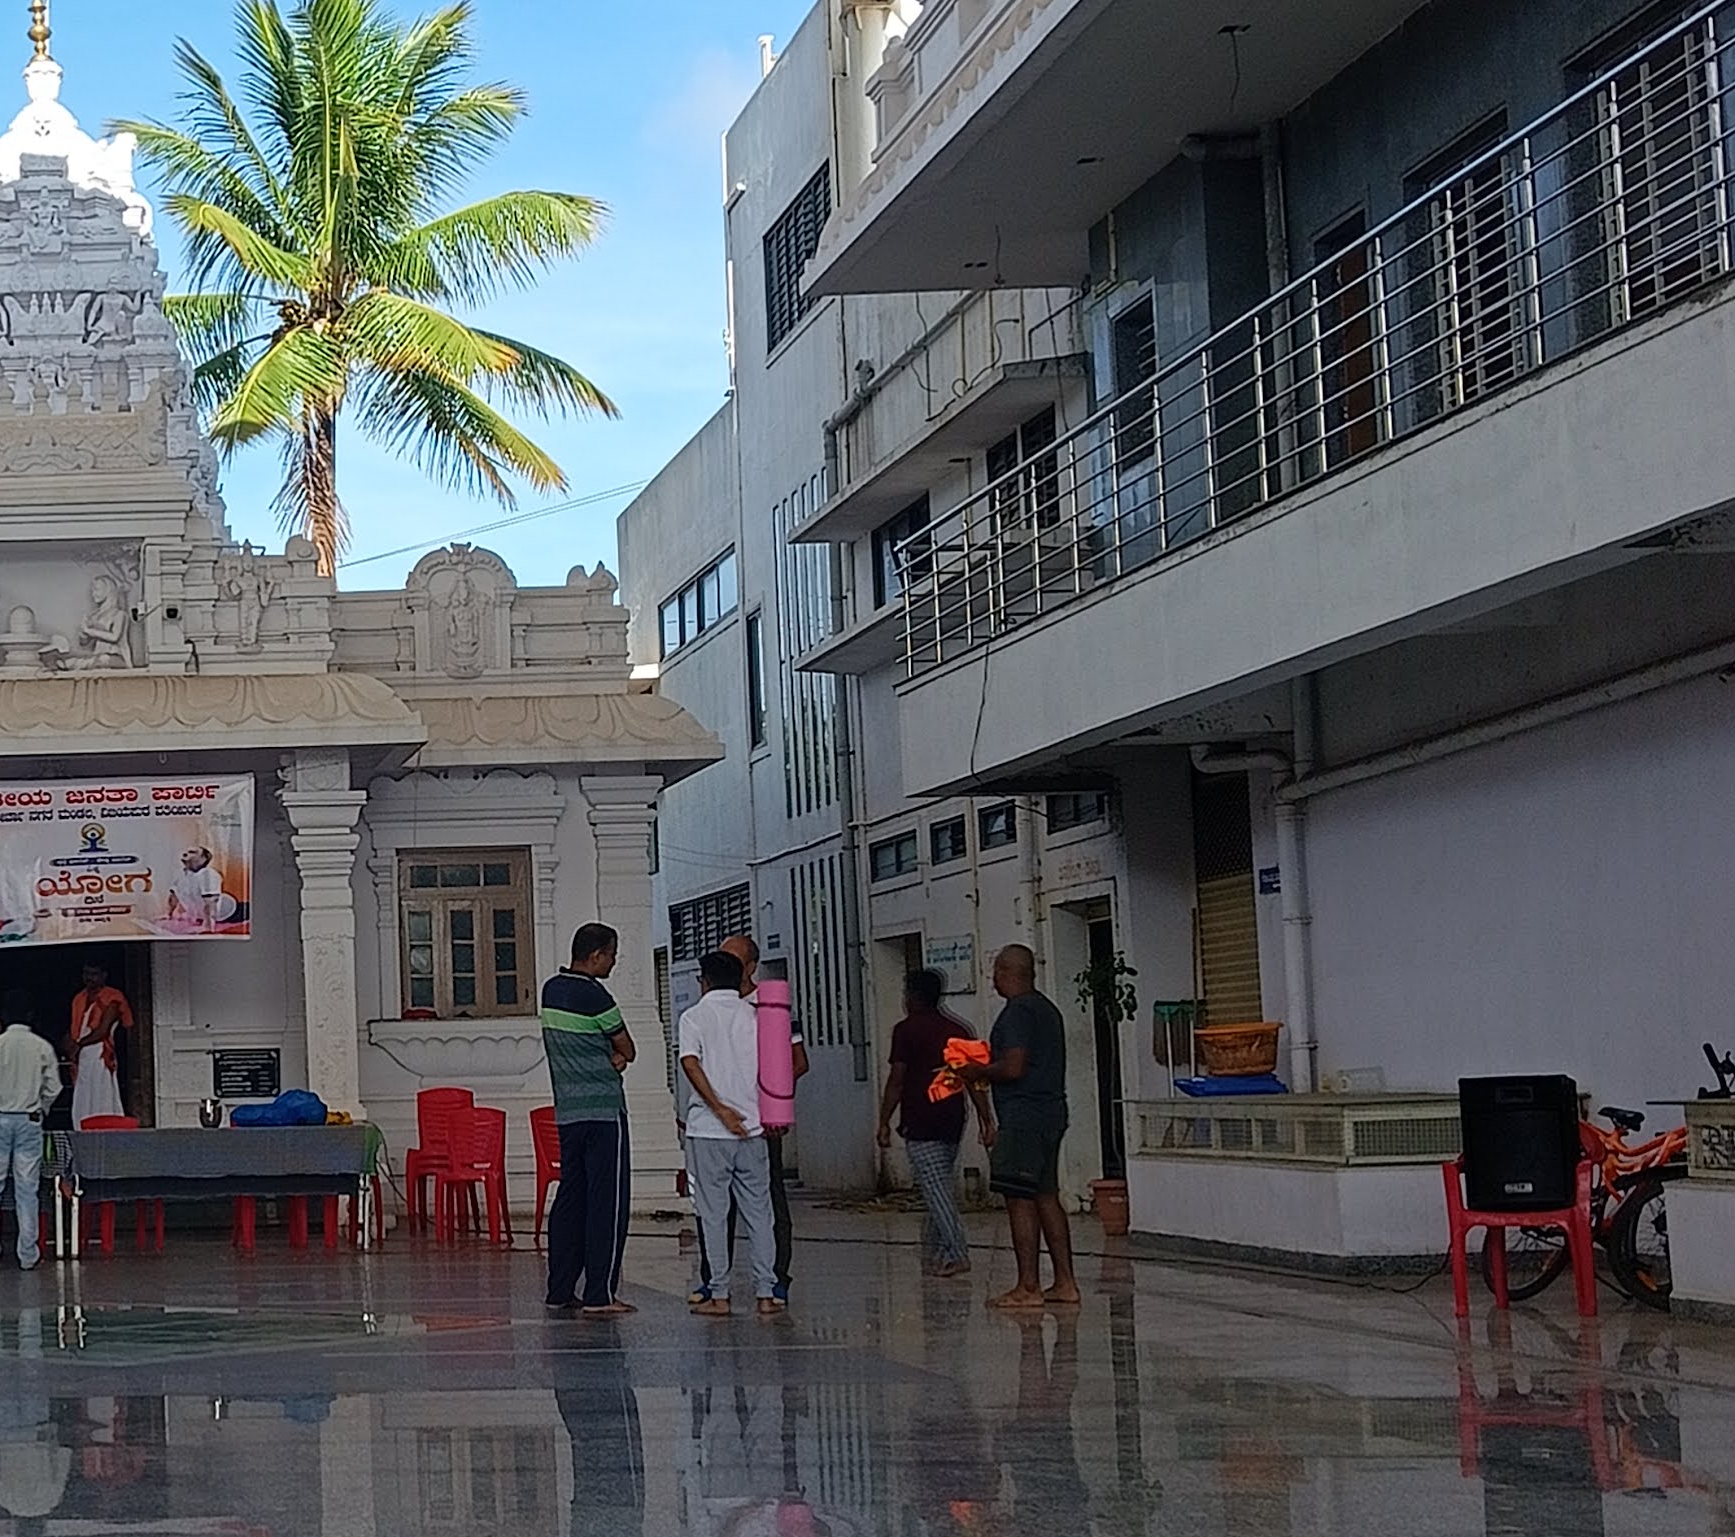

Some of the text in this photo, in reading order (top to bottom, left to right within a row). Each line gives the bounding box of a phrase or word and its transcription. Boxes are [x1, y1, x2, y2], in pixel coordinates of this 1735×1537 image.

[65, 786, 138, 805] ಜನತಾ
[151, 784, 221, 802] ಪಾರ್ಟಿ
[36, 867, 153, 897] ಯೋಗ
